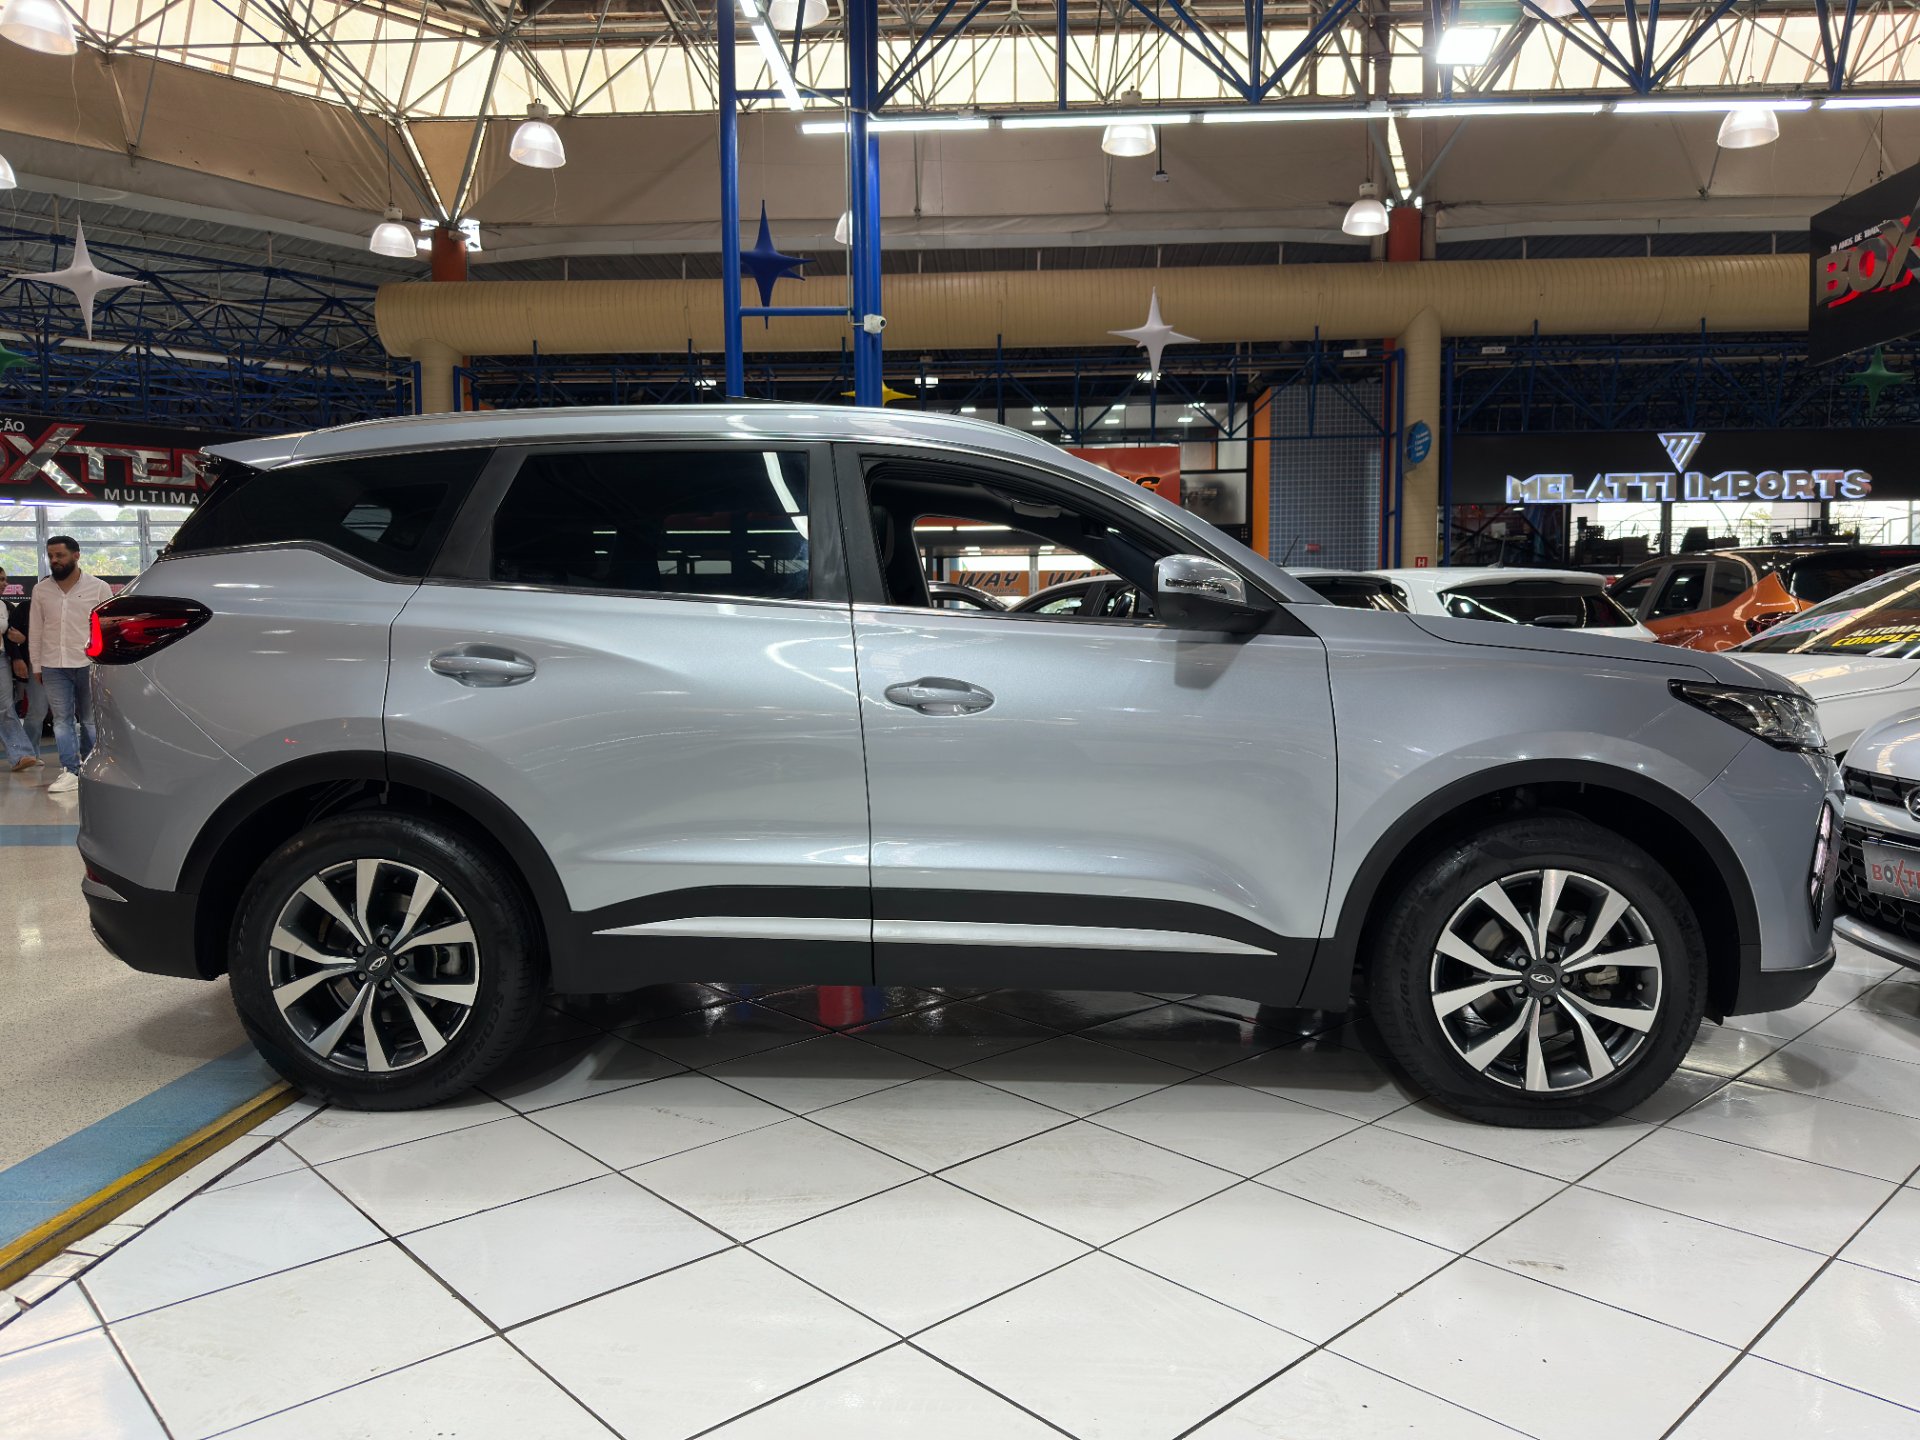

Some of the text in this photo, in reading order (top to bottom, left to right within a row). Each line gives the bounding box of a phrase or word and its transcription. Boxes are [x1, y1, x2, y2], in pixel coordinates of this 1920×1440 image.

[1506, 469, 1873, 504] MELATTI IMPORTS
[958, 572, 1019, 588] WAY
[1831, 632, 1920, 647] COMPLE
